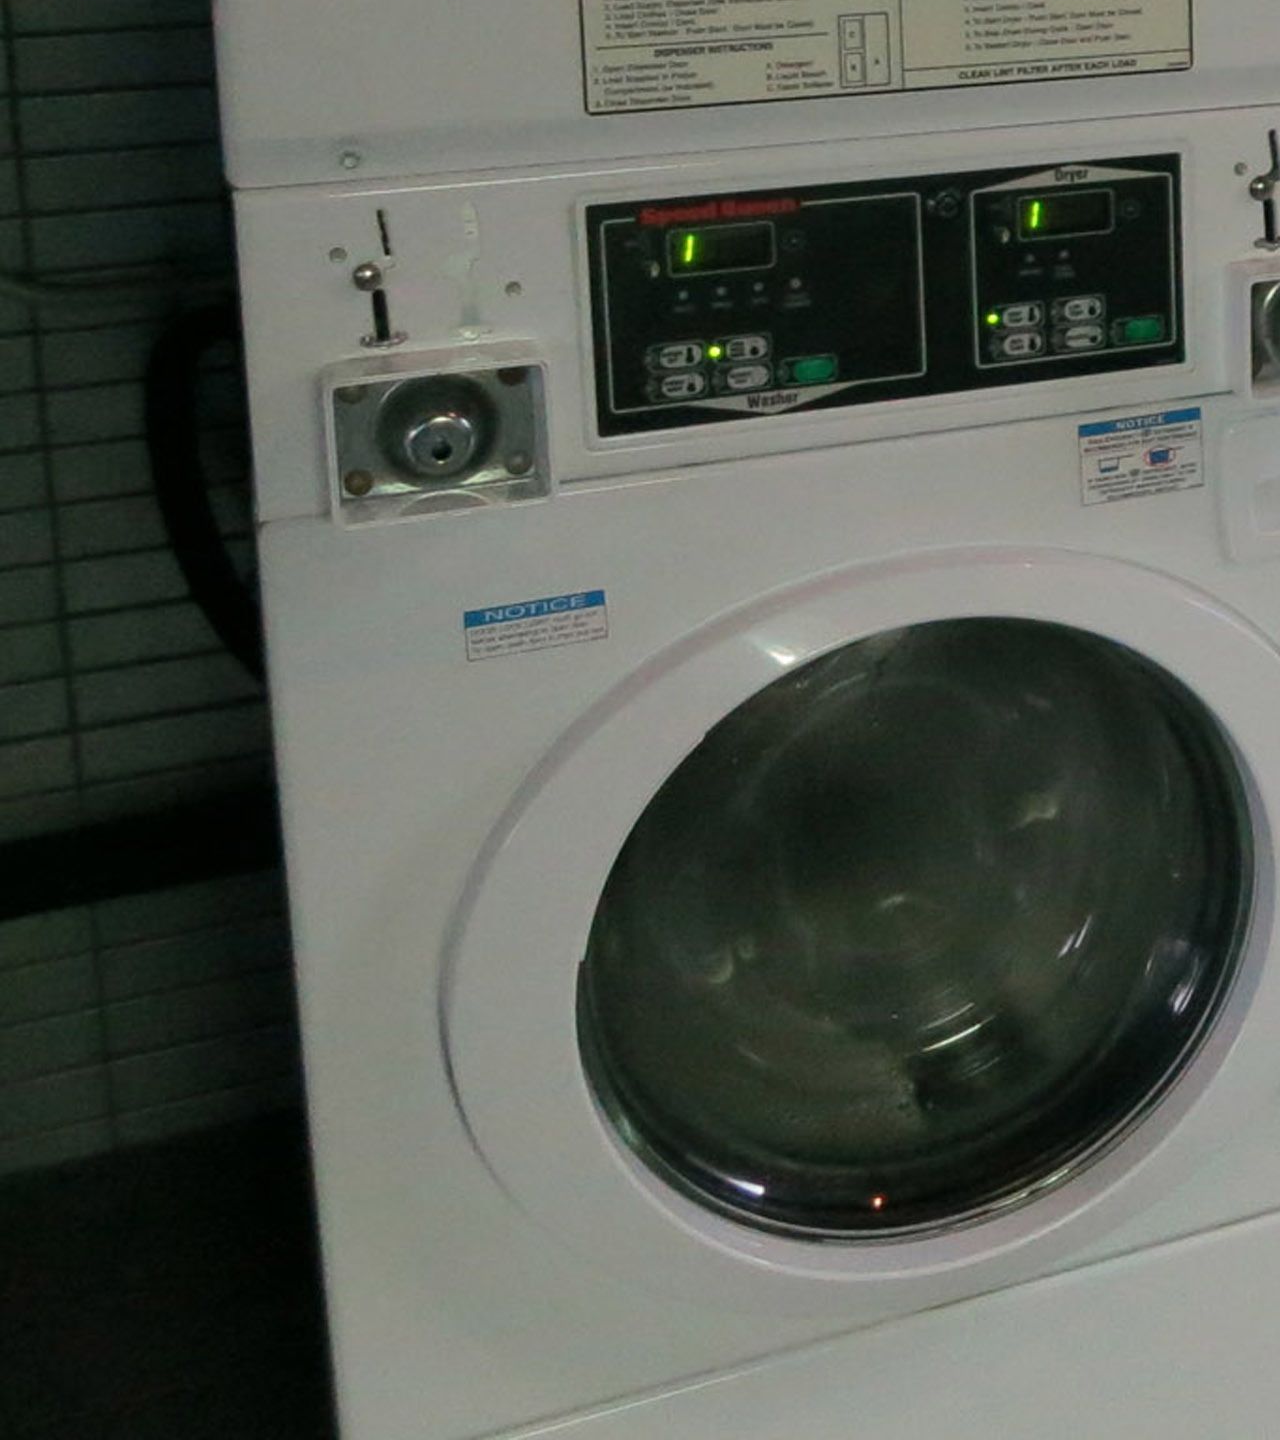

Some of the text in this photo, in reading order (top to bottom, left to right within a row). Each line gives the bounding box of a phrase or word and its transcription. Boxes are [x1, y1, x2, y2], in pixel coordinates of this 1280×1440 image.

[959, 68, 991, 80] CLEAN
[1017, 64, 1048, 76] FILTER
[1051, 62, 1083, 74] AFTER
[1085, 60, 1109, 71] EACH
[1111, 58, 1138, 70] LOAD
[1054, 168, 1089, 183] Dryer
[747, 392, 798, 409] Washer
[485, 594, 588, 622] NOTICE
